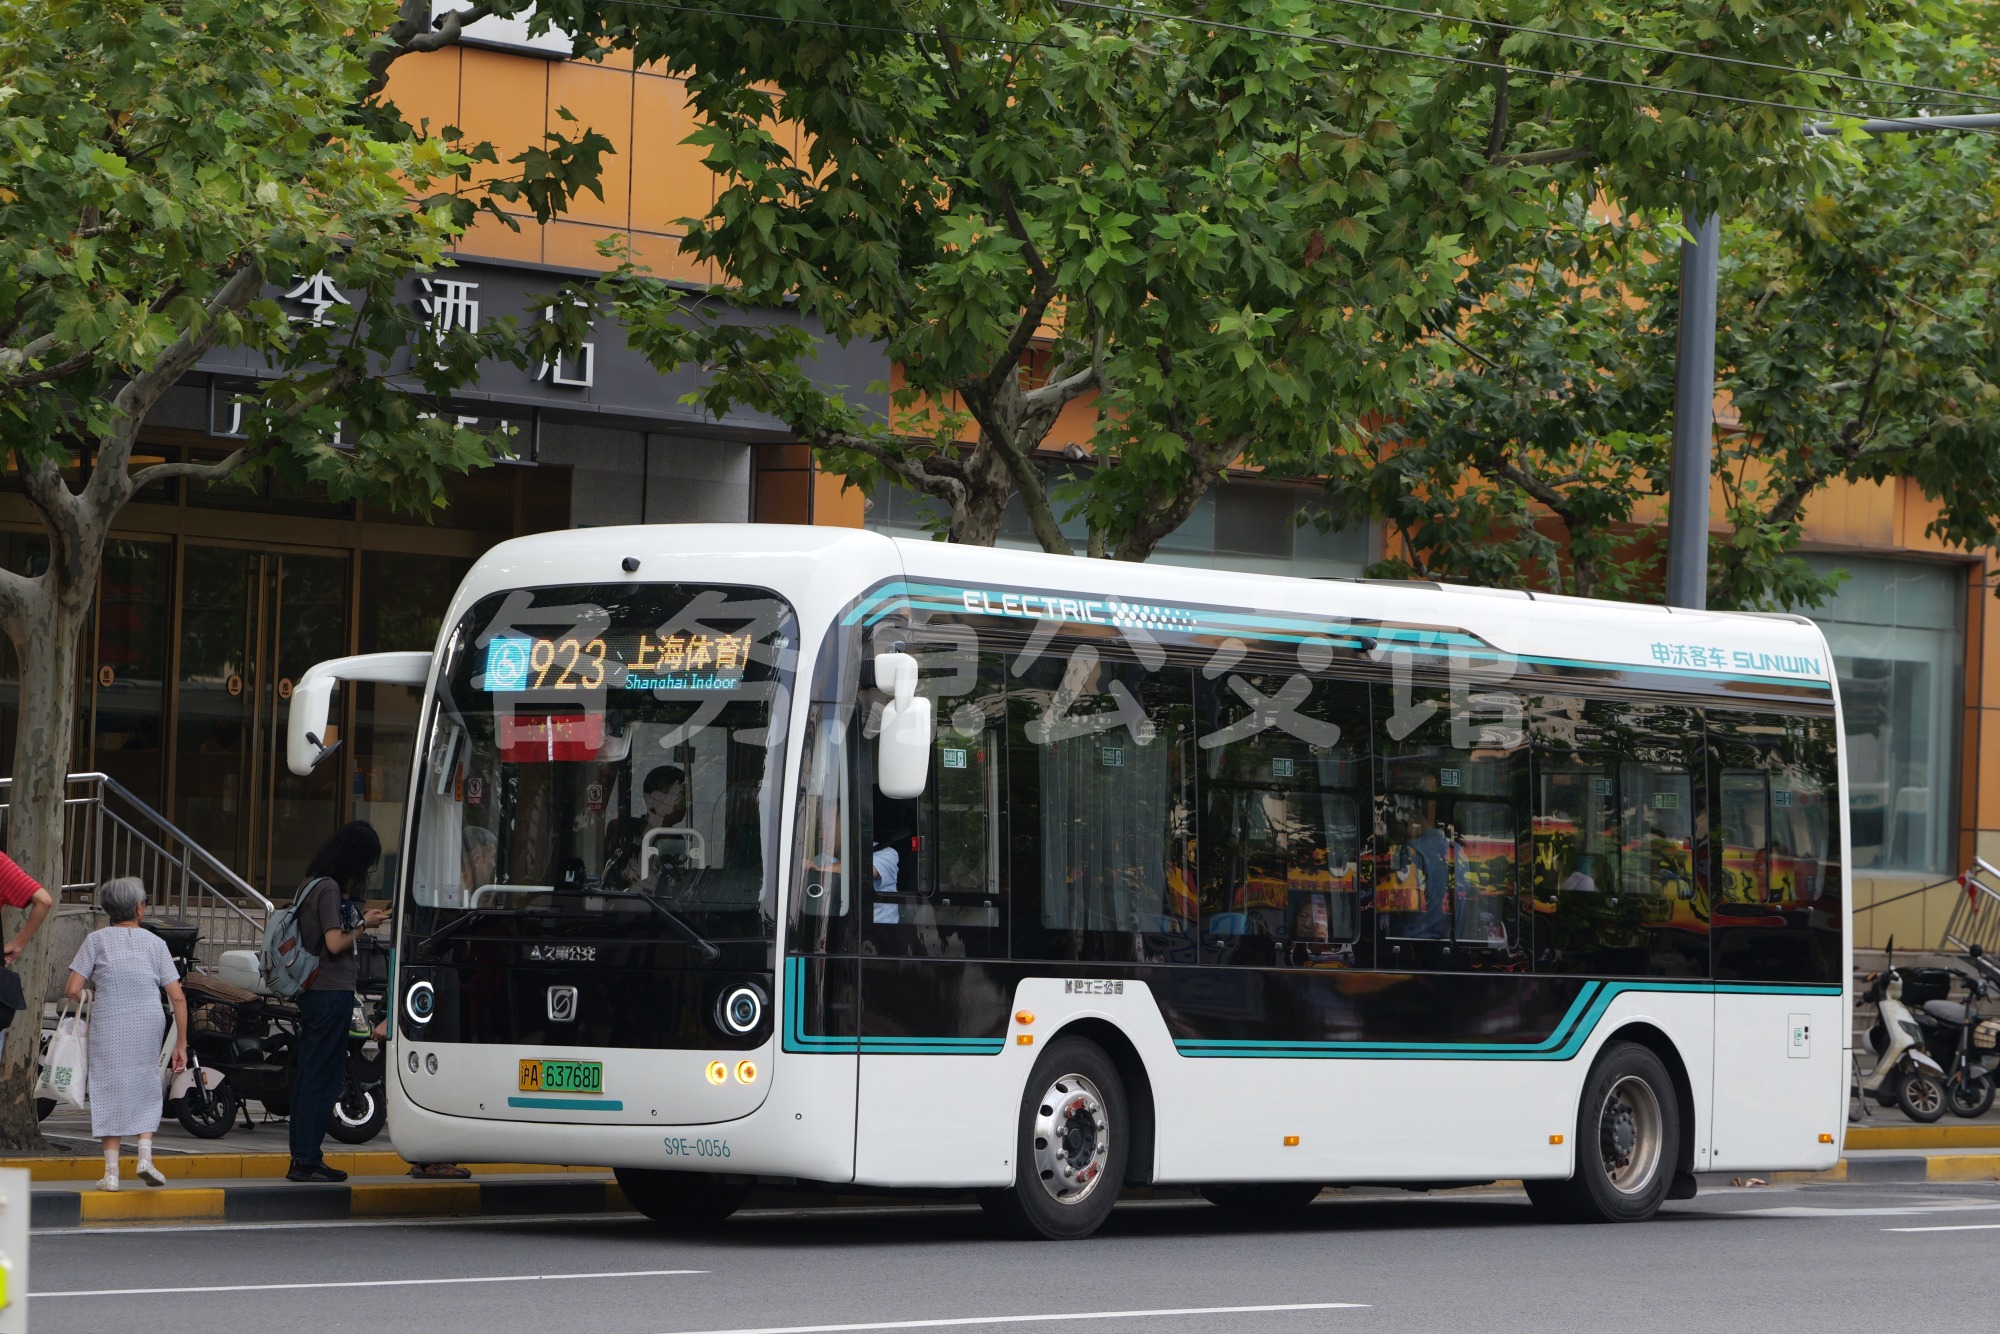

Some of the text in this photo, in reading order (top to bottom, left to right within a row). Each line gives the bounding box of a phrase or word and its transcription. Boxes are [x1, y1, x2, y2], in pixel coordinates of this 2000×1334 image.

[962, 590, 1106, 624] ELECTRIC
[530, 638, 607, 691] 923
[1650, 641, 1821, 676] 申沃客车 SUNWIN
[691, 673, 738, 690] Indoor
[664, 1137, 731, 1158] S9E-0056
